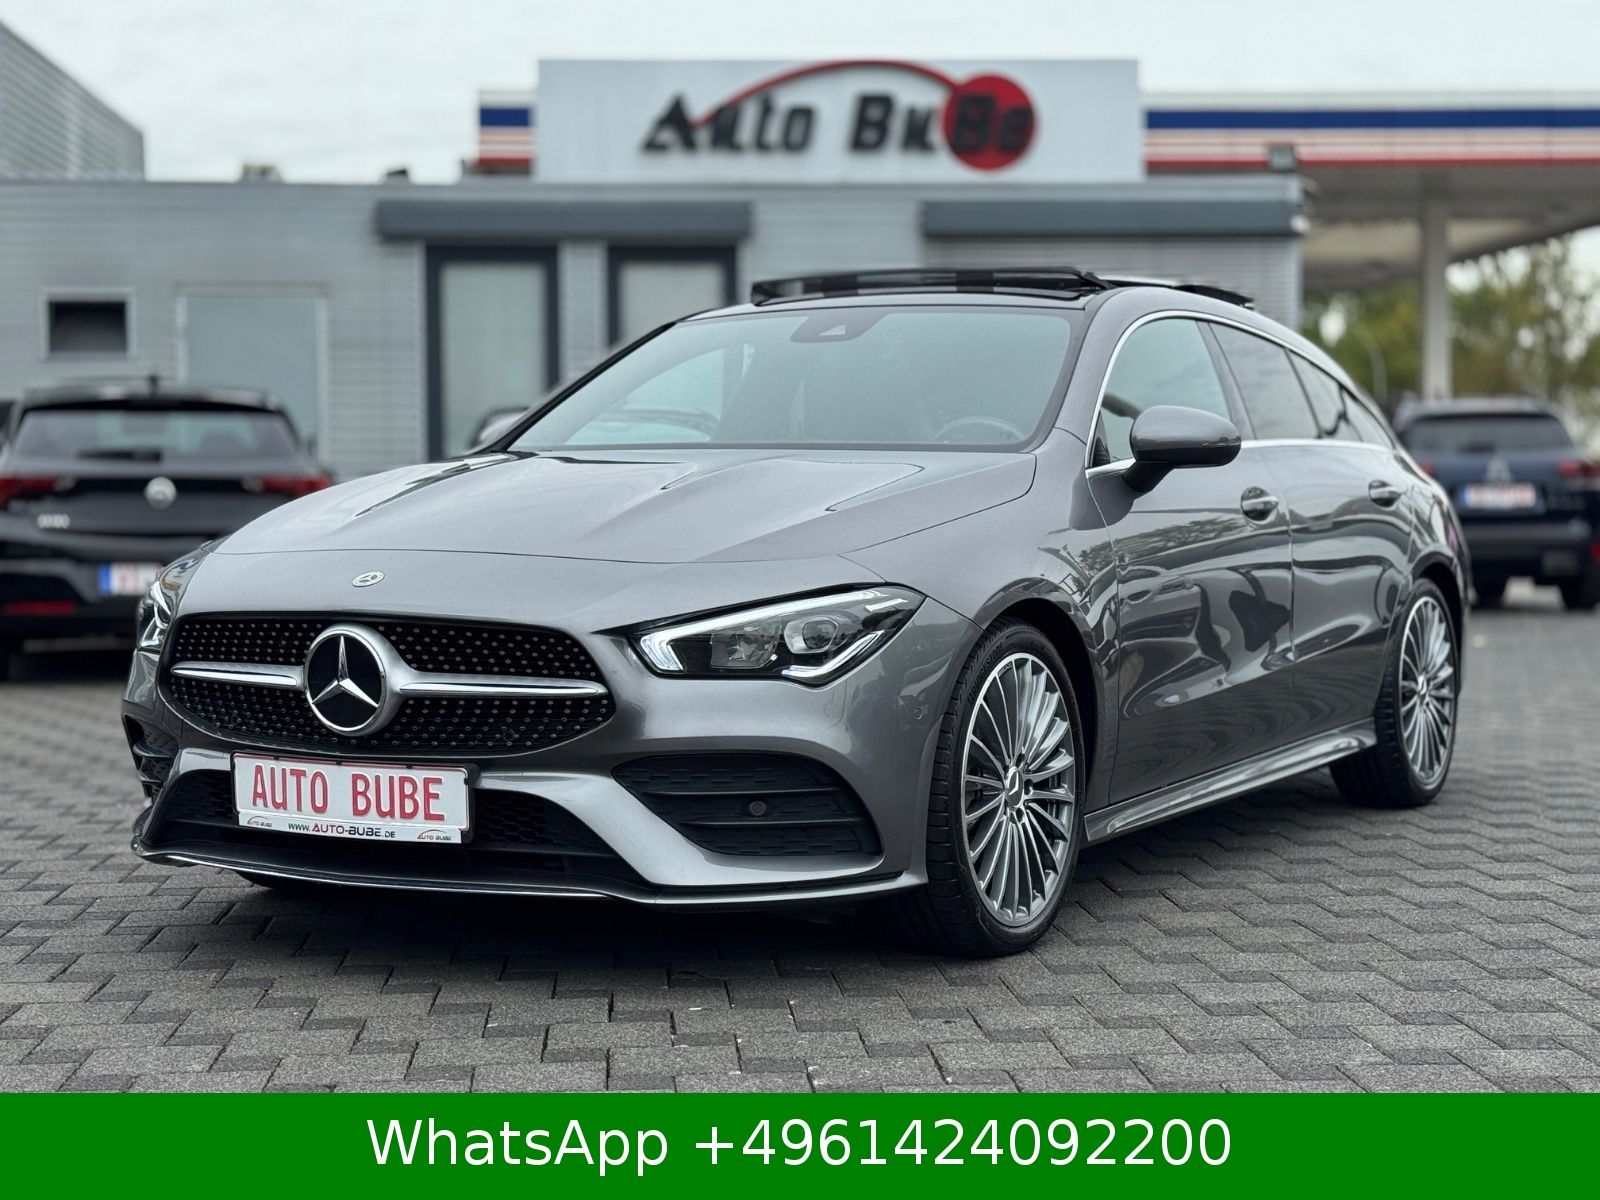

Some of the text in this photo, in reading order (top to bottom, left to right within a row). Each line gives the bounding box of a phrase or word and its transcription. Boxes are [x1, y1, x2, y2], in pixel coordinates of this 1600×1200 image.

[643, 92, 814, 154] Auto
[967, 641, 1005, 705] BRIDGESTONE
[252, 764, 445, 821] AUTO BUBE
